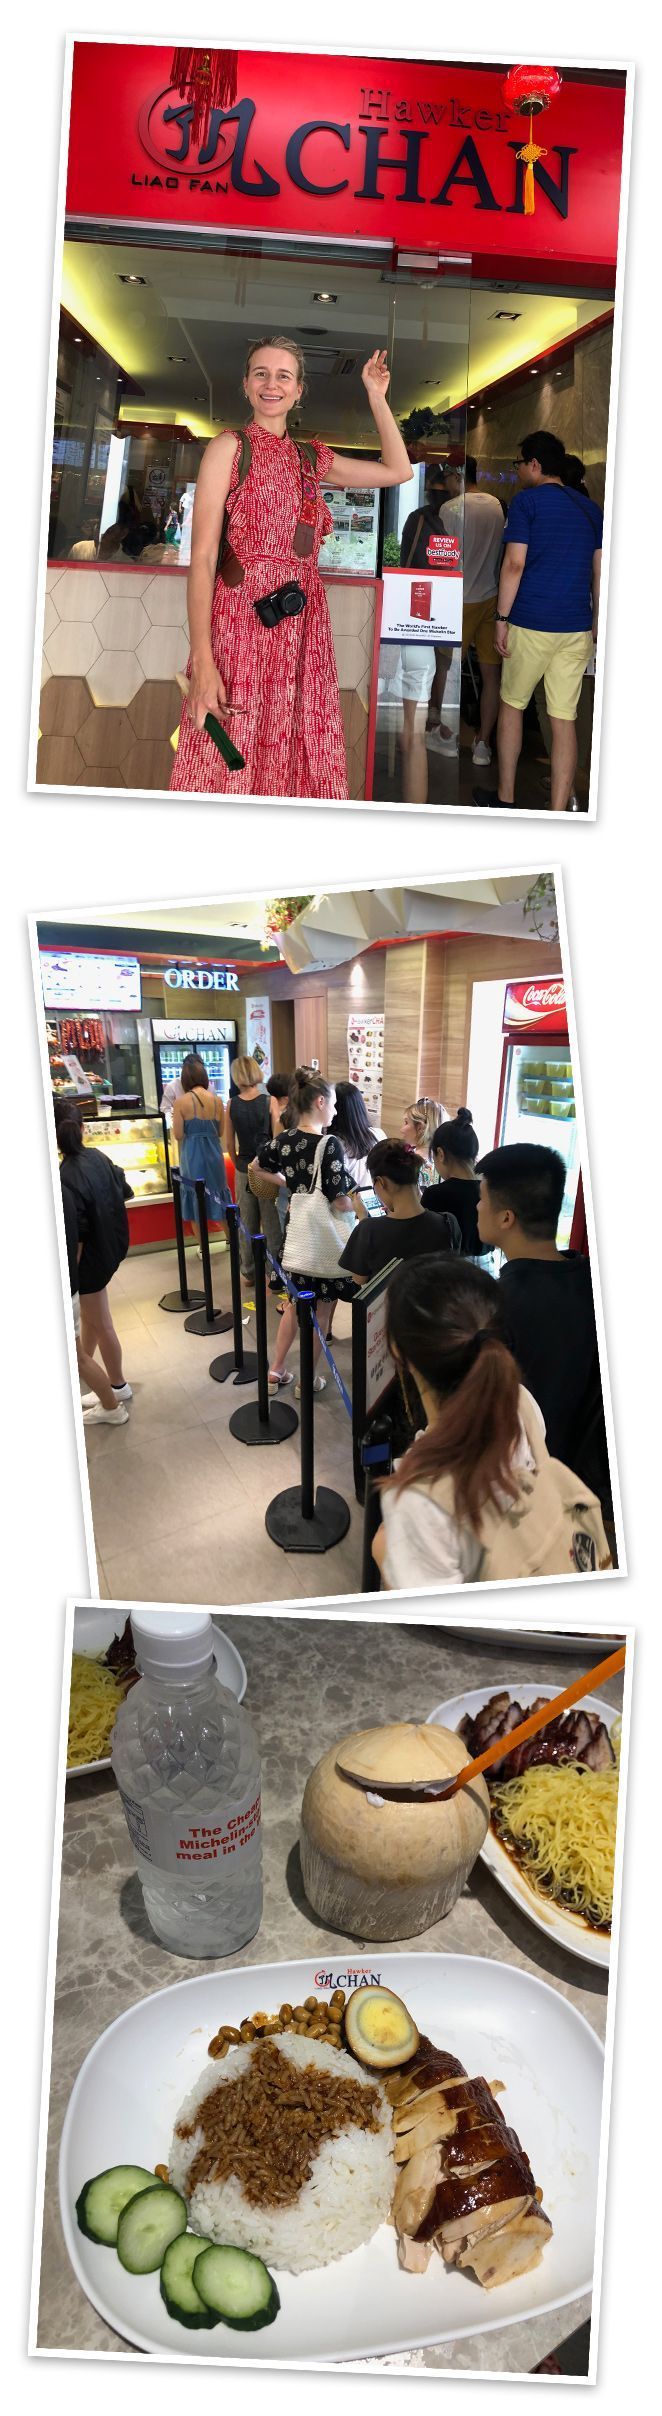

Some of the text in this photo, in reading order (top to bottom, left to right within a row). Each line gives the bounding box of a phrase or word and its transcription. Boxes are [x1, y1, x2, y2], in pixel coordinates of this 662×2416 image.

[359, 87, 512, 133] Hawker
[286, 120, 578, 220] CHAN
[131, 174, 229, 194] LIAO FAN
[164, 968, 240, 991] ORDER
[185, 1027, 227, 1041] CHAN
[189, 1827, 222, 1838] The
[176, 1828, 256, 1860] meal in the
[336, 1973, 382, 1988] CHAN
